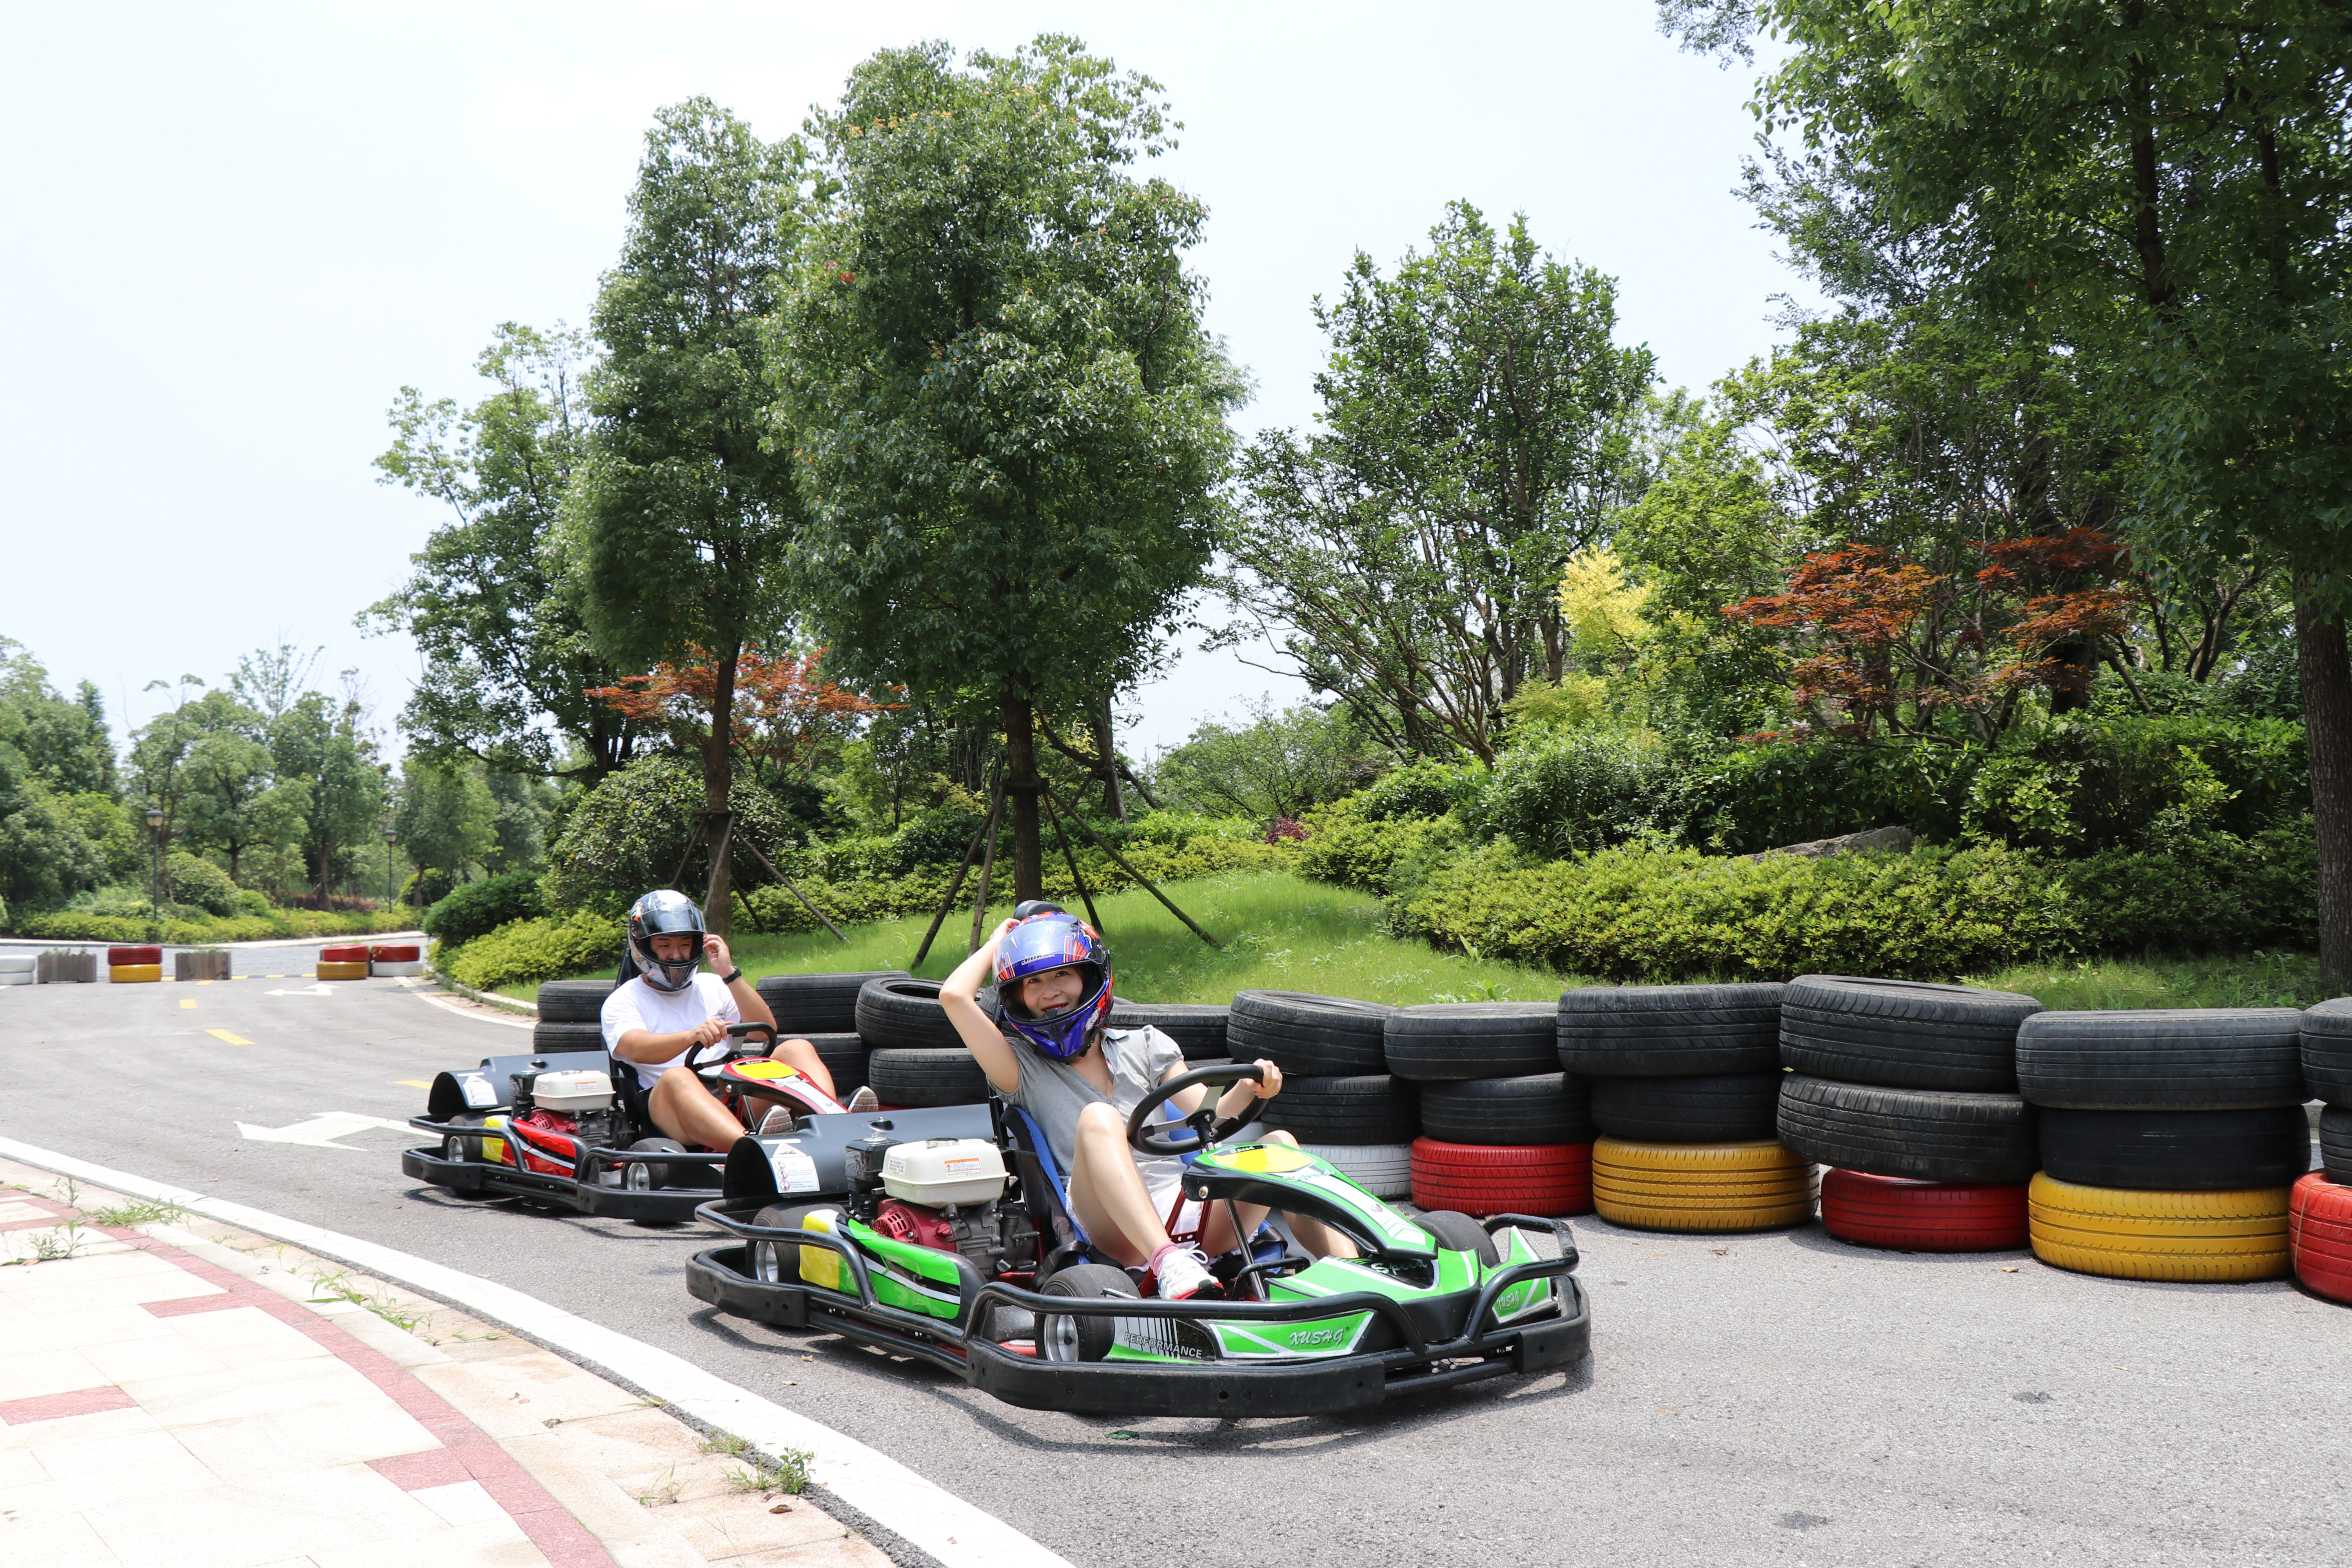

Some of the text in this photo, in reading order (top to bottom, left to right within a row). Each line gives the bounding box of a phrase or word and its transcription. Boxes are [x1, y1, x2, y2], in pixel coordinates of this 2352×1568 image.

[775, 1078, 809, 1087] Speed
[1282, 1169, 1336, 1182] Speed
[1370, 1259, 1428, 1275] Speed
[1124, 1332, 1203, 1359] PERFORMANCE
